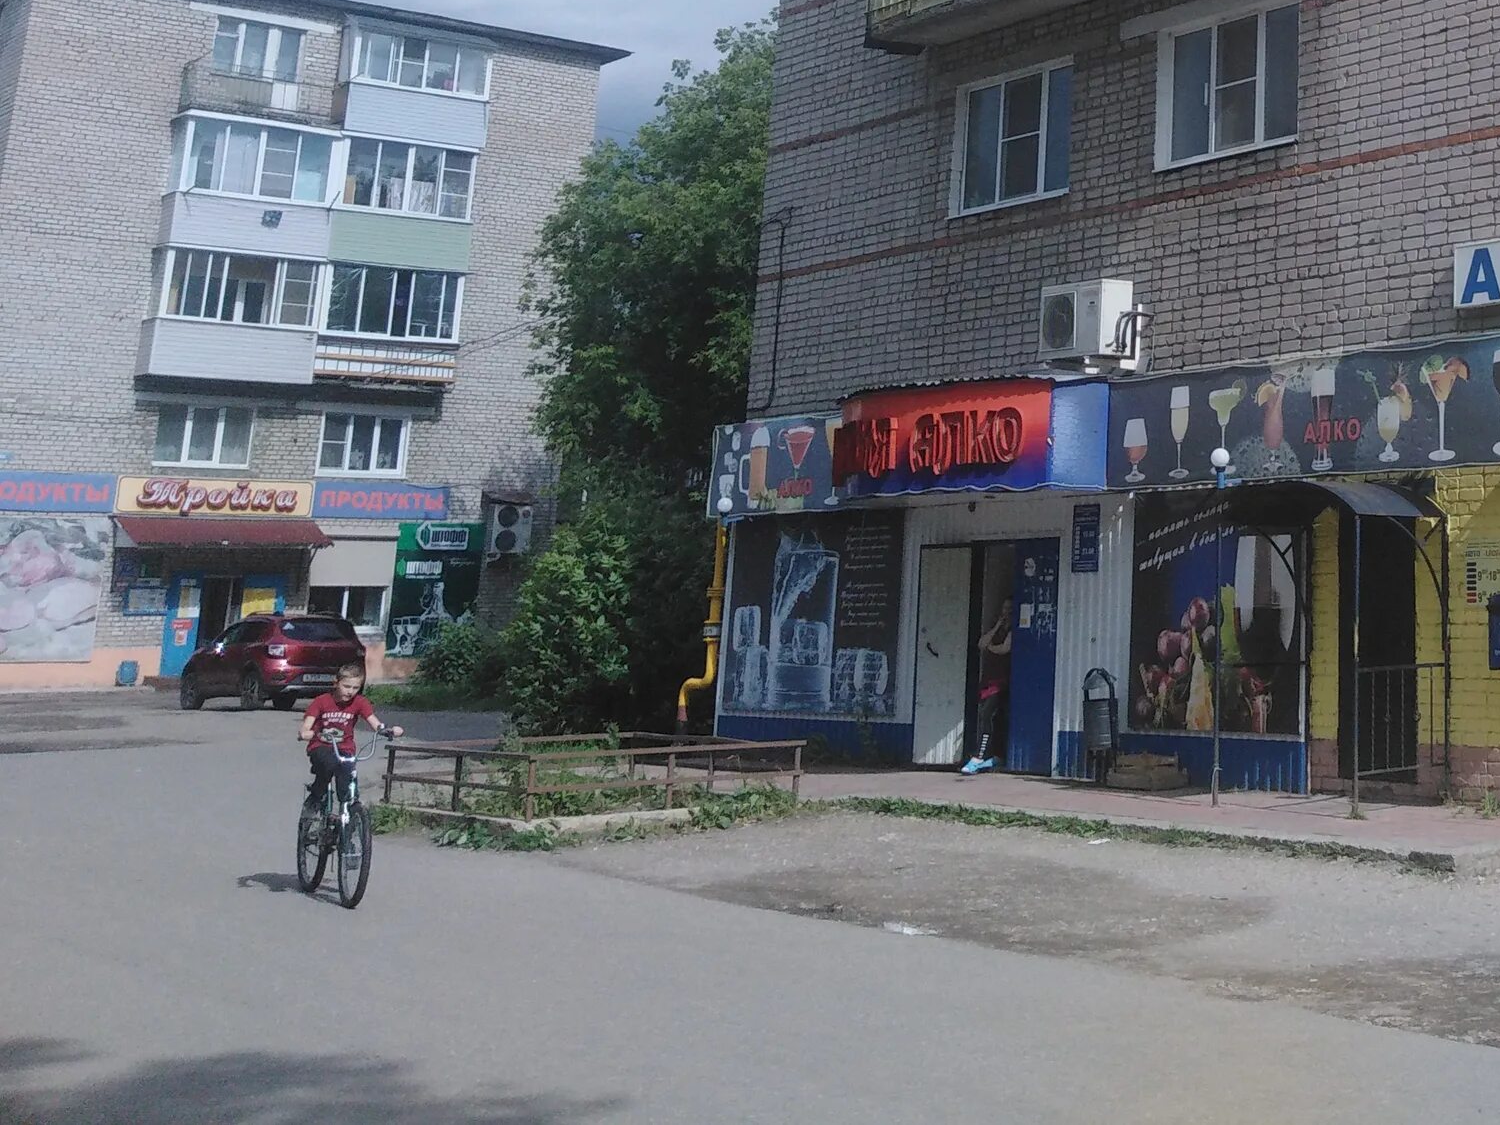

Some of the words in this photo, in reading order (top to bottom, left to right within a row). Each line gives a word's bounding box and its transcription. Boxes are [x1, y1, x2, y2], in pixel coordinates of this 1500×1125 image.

[909, 407, 1024, 475] АЛКО
[1303, 417, 1361, 444] АЛКО
[136, 477, 299, 516] Тройка
[320, 489, 445, 512] ПРОДУКТЫ
[431, 530, 467, 544] ШТОФФ
[406, 560, 442, 575] ШТОФФ
